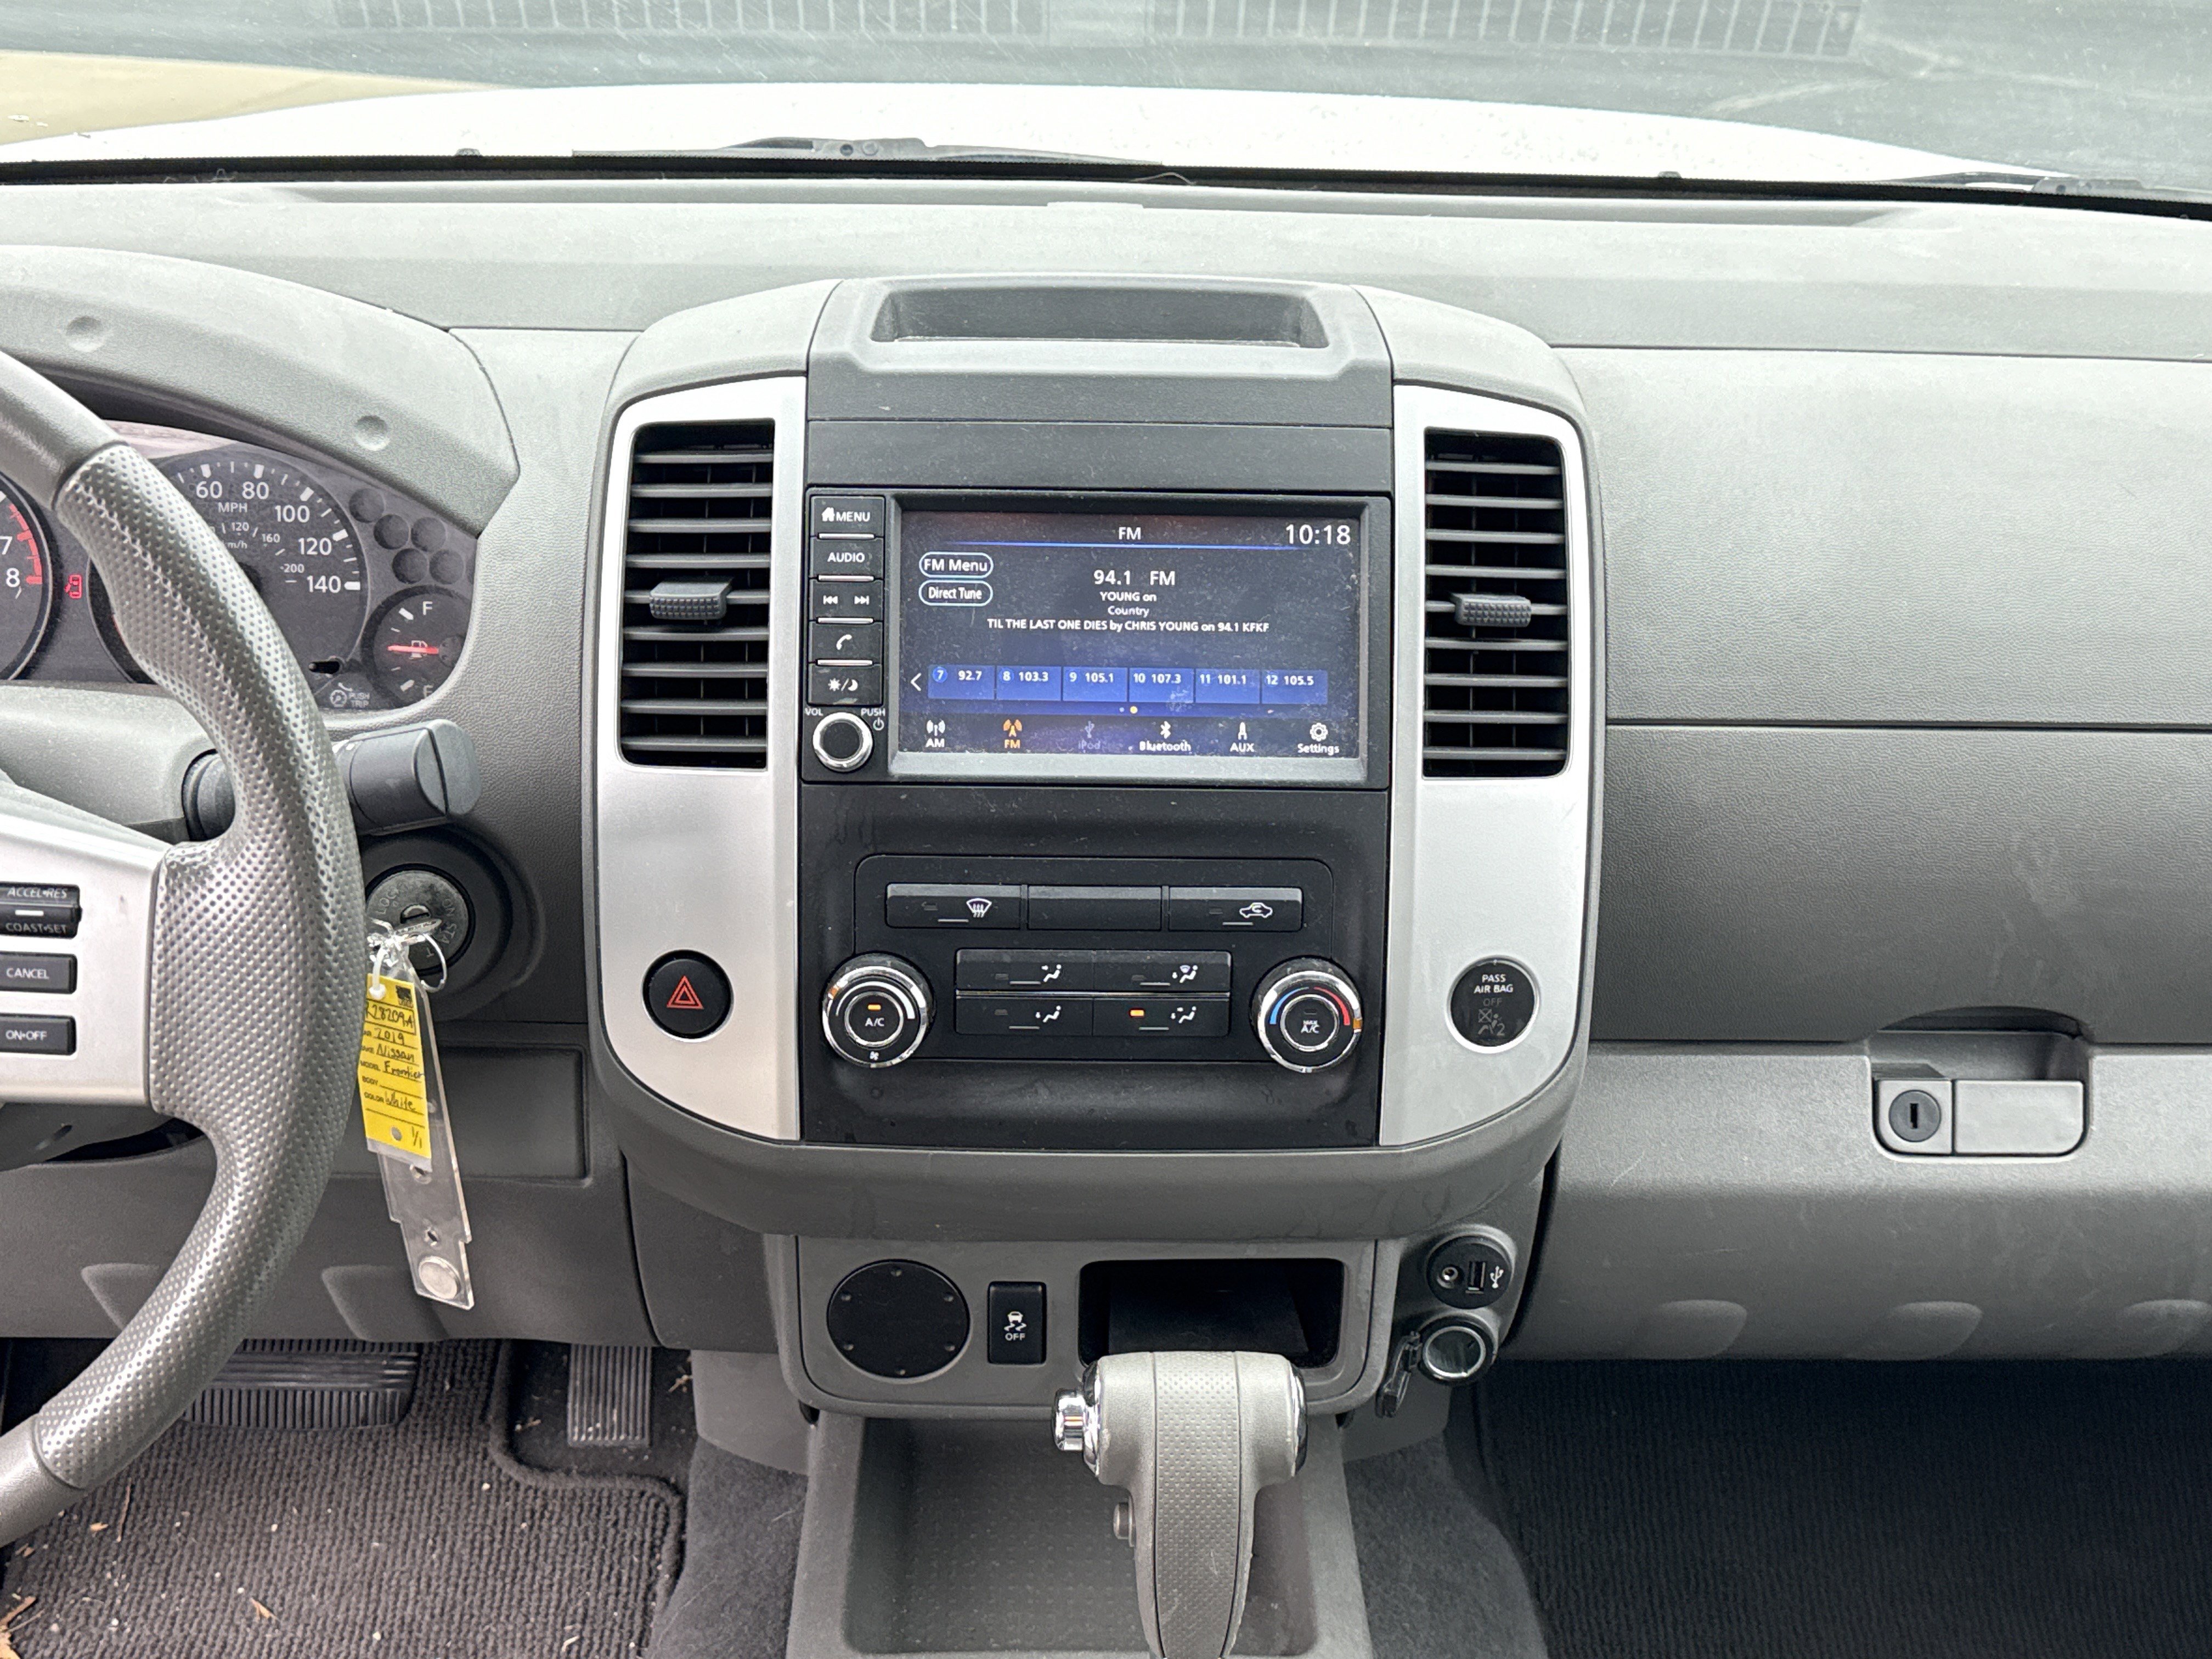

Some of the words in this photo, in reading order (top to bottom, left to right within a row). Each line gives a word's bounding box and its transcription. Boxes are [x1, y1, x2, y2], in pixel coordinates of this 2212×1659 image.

[196, 481, 222, 499] 60
[242, 481, 269, 500] 80
[218, 502, 247, 513] MPH
[275, 505, 311, 523] 100
[836, 511, 871, 522] MENU
[232, 522, 249, 532] 120
[262, 533, 280, 543] 160
[1119, 527, 1142, 540] FM
[1286, 524, 1351, 545] 10:18
[0, 535, 13, 555] 7
[225, 540, 247, 549] m/h
[298, 537, 332, 556] 120
[827, 552, 866, 563] AUDIO
[284, 563, 304, 573] 200
[924, 558, 945, 571] FM
[949, 558, 988, 572] Menu
[6, 567, 20, 588] 8
[1093, 569, 1131, 585] 94.1
[1150, 570, 1176, 586] FM
[307, 575, 341, 594] 140
[928, 586, 957, 600] Direct
[958, 586, 983, 600] Tune
[1099, 591, 1140, 602] YOUNG
[1142, 594, 1157, 602] on
[422, 601, 433, 616] F
[1107, 606, 1150, 618] Country
[987, 618, 1003, 629] TIL
[1005, 619, 1027, 629] THE
[1029, 619, 1056, 630] LAST
[1057, 619, 1081, 630] ONE
[1083, 620, 1108, 631] DIES
[1109, 620, 1123, 633] by
[1125, 620, 1156, 631] CHRIS
[1158, 621, 1198, 631] YOUNG
[1201, 623, 1215, 632] on
[1217, 622, 1239, 632] 94.1
[1242, 622, 1269, 633] KFKF
[936, 670, 944, 681] 7
[958, 670, 982, 681] 92.7
[1002, 671, 1011, 681] 8
[1018, 672, 1049, 682] 103.3
[1069, 672, 1077, 682] 9
[1085, 672, 1114, 683] 105.1
[1133, 673, 1146, 684] 10
[1152, 674, 1181, 684] 107.3
[1200, 674, 1211, 684] 11
[1218, 675, 1246, 685] 101.1
[1266, 675, 1279, 685] 12
[1284, 675, 1314, 686] 105.5
[351, 699, 369, 708] TRIP
[805, 708, 823, 716] VOL
[860, 708, 885, 716] PUSH
[926, 738, 945, 748] AM
[1004, 740, 1020, 749] FM
[1139, 740, 1192, 752] Bluetooth
[1230, 742, 1255, 752] AUX
[1297, 743, 1340, 756] Settings
[6, 967, 50, 980] CANCEL
[1482, 973, 1506, 983] PASS
[1474, 984, 1491, 994] AIR
[1493, 984, 1514, 993] BAG
[1483, 997, 1503, 1007] OFF
[865, 1017, 885, 1027] A/C
[374, 1027, 405, 1046] 2019
[376, 1043, 415, 1063] Nissan
[1005, 1333, 1025, 1341] OFF
